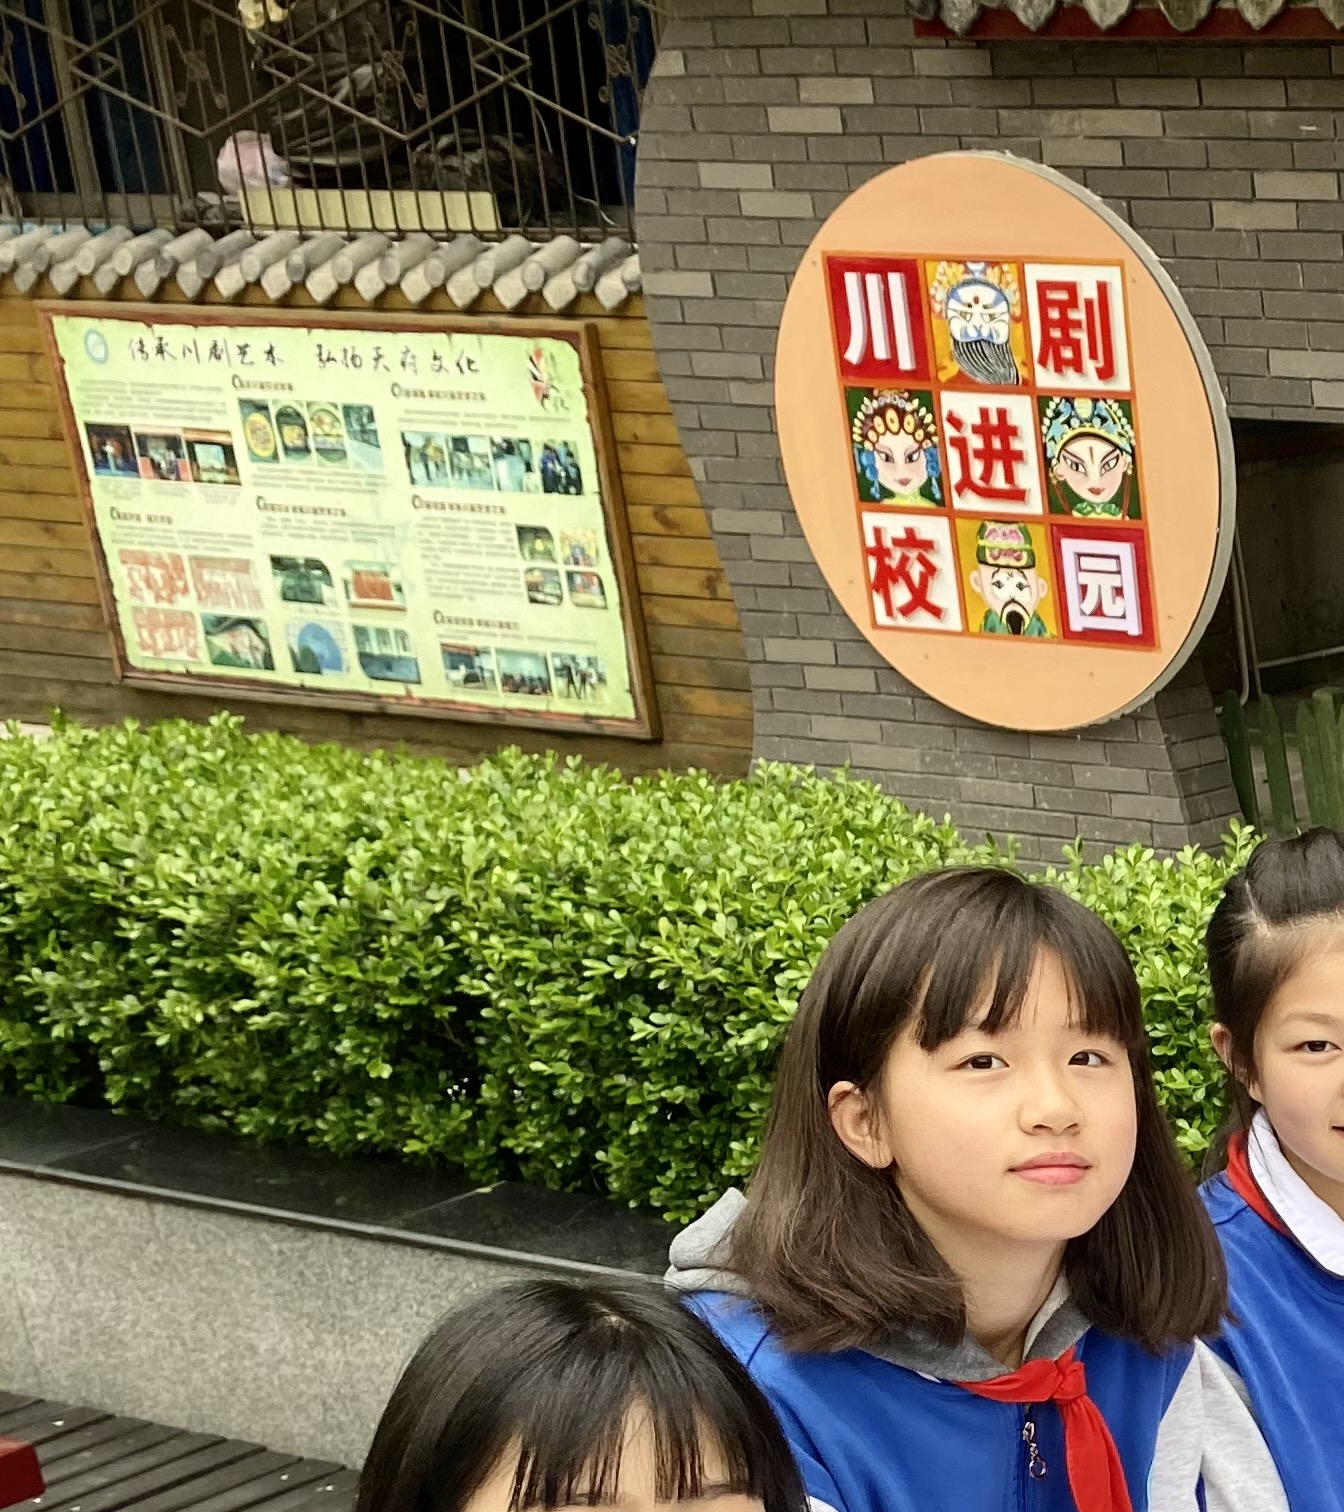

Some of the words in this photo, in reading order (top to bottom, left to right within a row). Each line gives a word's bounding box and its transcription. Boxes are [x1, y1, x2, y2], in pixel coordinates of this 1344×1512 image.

[129, 336, 284, 367] 传承川剧艺术
[316, 343, 480, 375] 弘扬天府文化
[843, 271, 916, 371] 川
[1036, 280, 1115, 380] 剧
[948, 406, 1027, 504] 进
[867, 528, 945, 619] 校
[1060, 538, 1143, 636] 园
